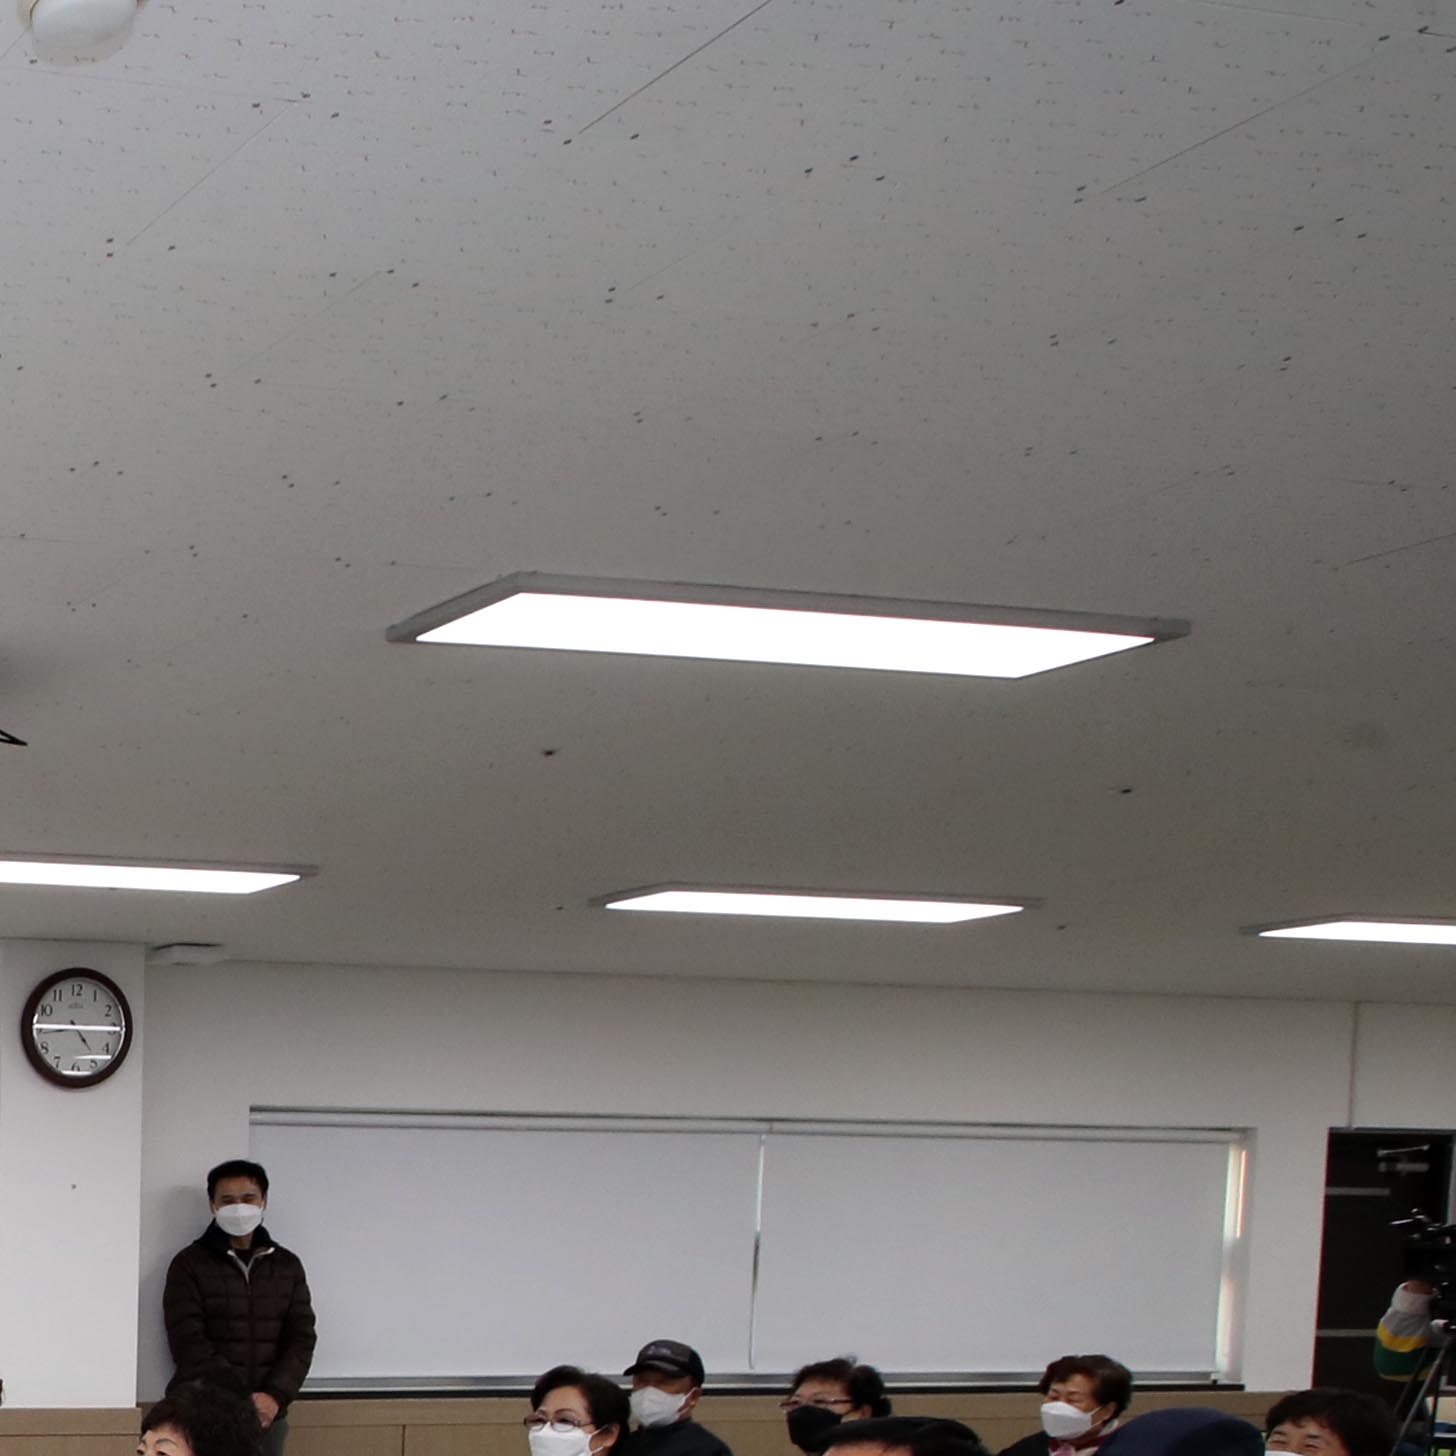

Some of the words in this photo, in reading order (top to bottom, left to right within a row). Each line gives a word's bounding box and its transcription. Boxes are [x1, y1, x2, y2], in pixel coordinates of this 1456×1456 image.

[53, 989, 63, 1002] 11
[71, 983, 84, 997] 12
[40, 1004, 53, 1017] 10
[104, 1004, 113, 1017] 2
